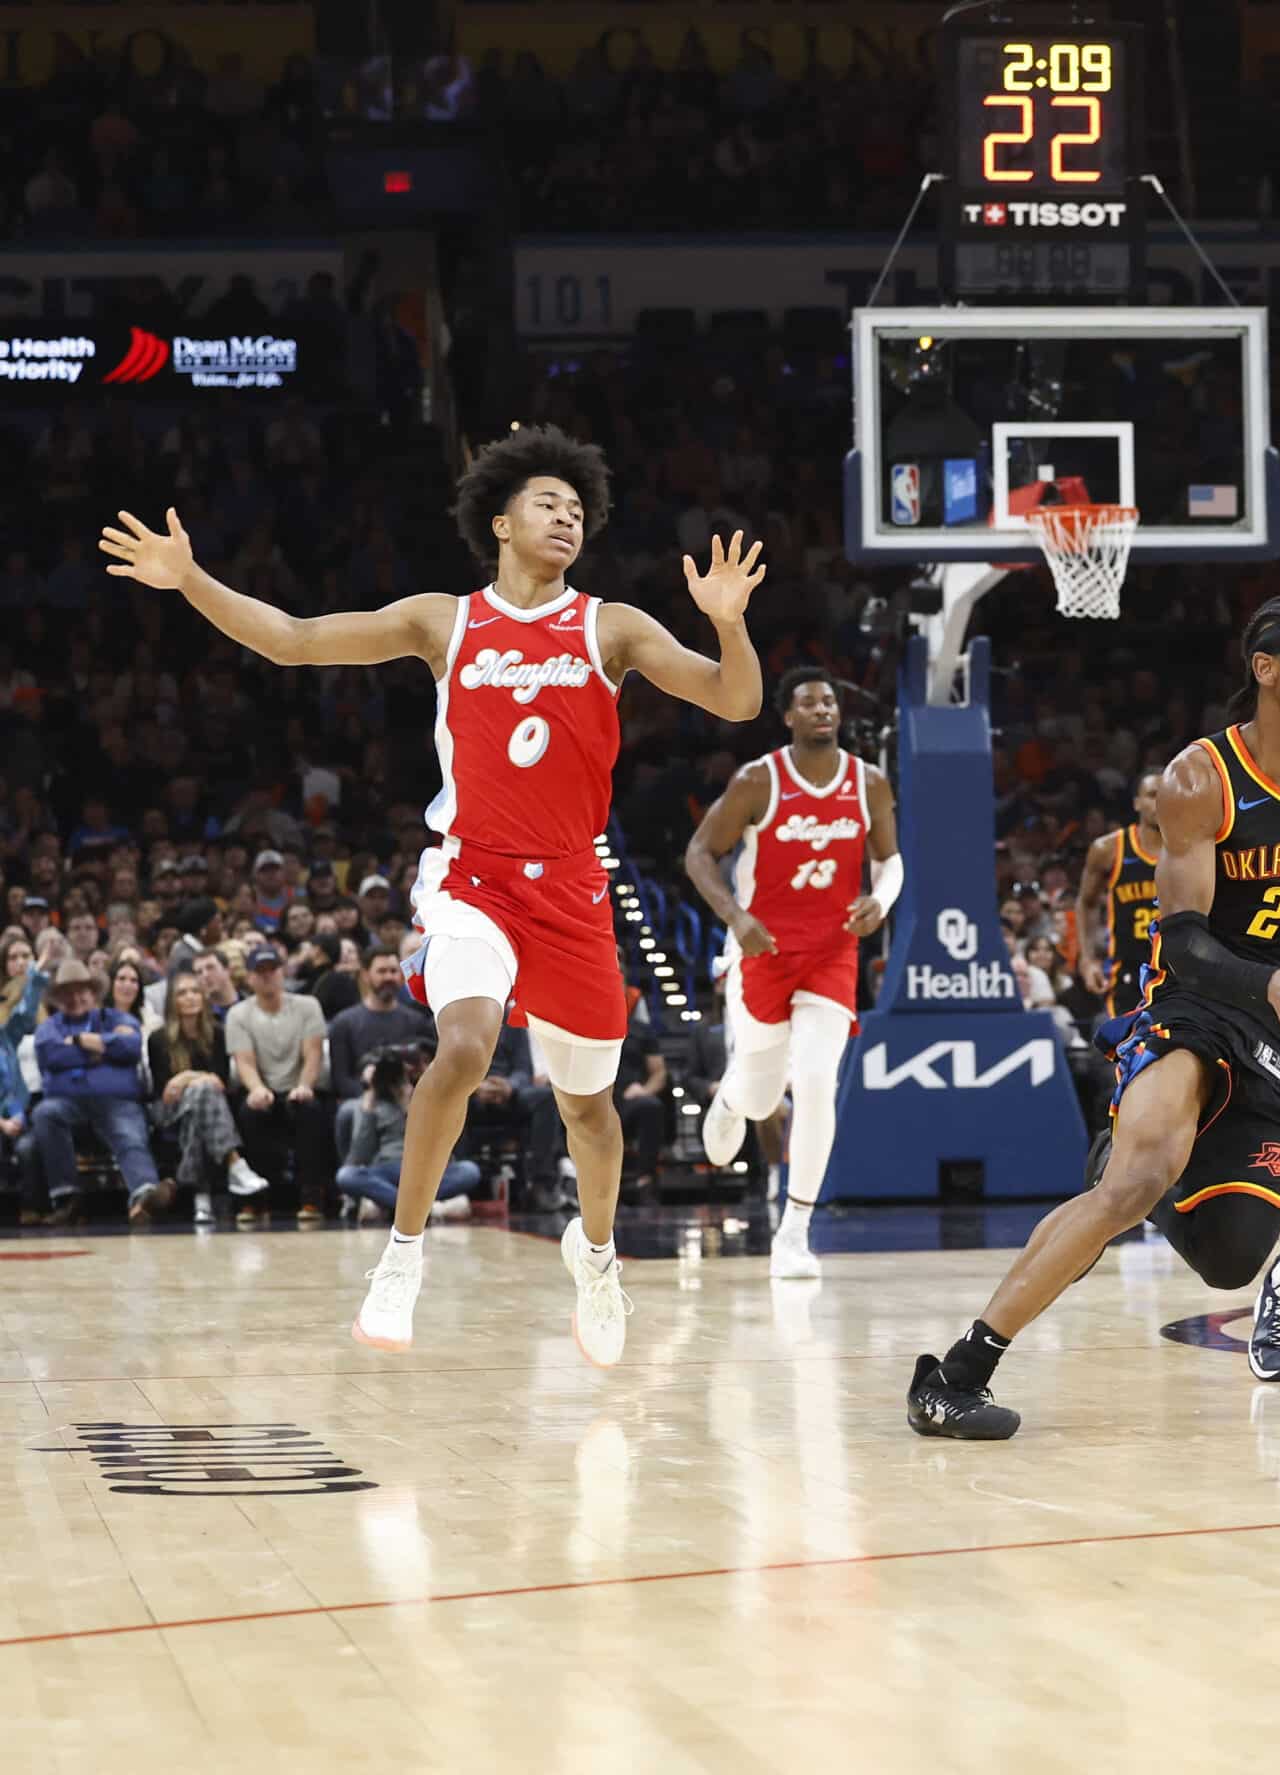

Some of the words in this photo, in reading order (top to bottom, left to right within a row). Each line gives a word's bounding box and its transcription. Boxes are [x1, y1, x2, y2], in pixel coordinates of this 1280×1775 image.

[1003, 44, 1111, 92] 2:09
[983, 95, 1101, 182] 22
[1008, 203, 1126, 226] TISSOT
[527, 273, 613, 326] 101
[12, 336, 96, 358] Health
[173, 336, 227, 359] Dean
[459, 648, 593, 705] Memphis
[507, 715, 550, 768] 0
[775, 814, 861, 851] Memphis
[790, 859, 837, 890] 13
[936, 908, 978, 960] OU
[1133, 907, 1161, 940] 2
[907, 960, 1015, 1000] Health
[862, 1038, 1055, 1090] KIA
